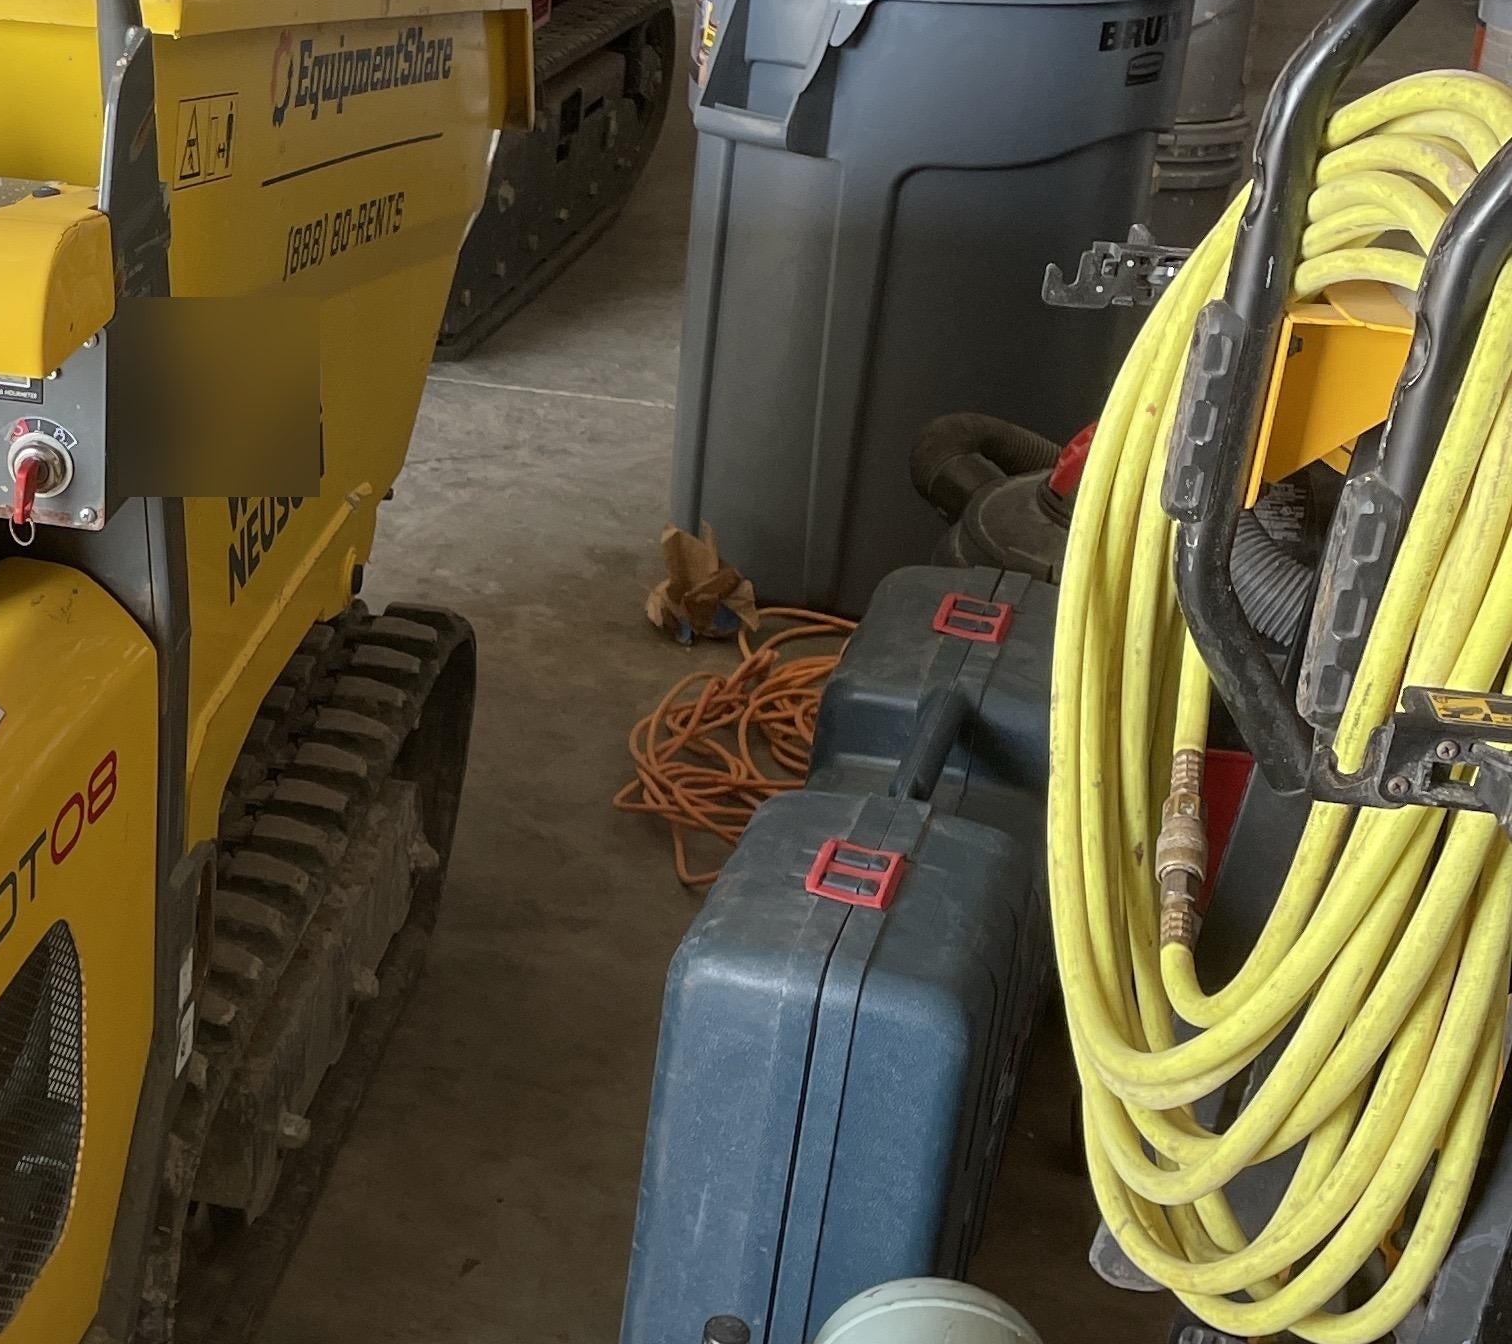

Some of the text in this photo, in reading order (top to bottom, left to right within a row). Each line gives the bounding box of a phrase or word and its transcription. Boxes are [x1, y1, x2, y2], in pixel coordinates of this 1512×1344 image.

[294, 27, 454, 120] EquipmentShare
[282, 191, 405, 282] (888) 80-RENTS
